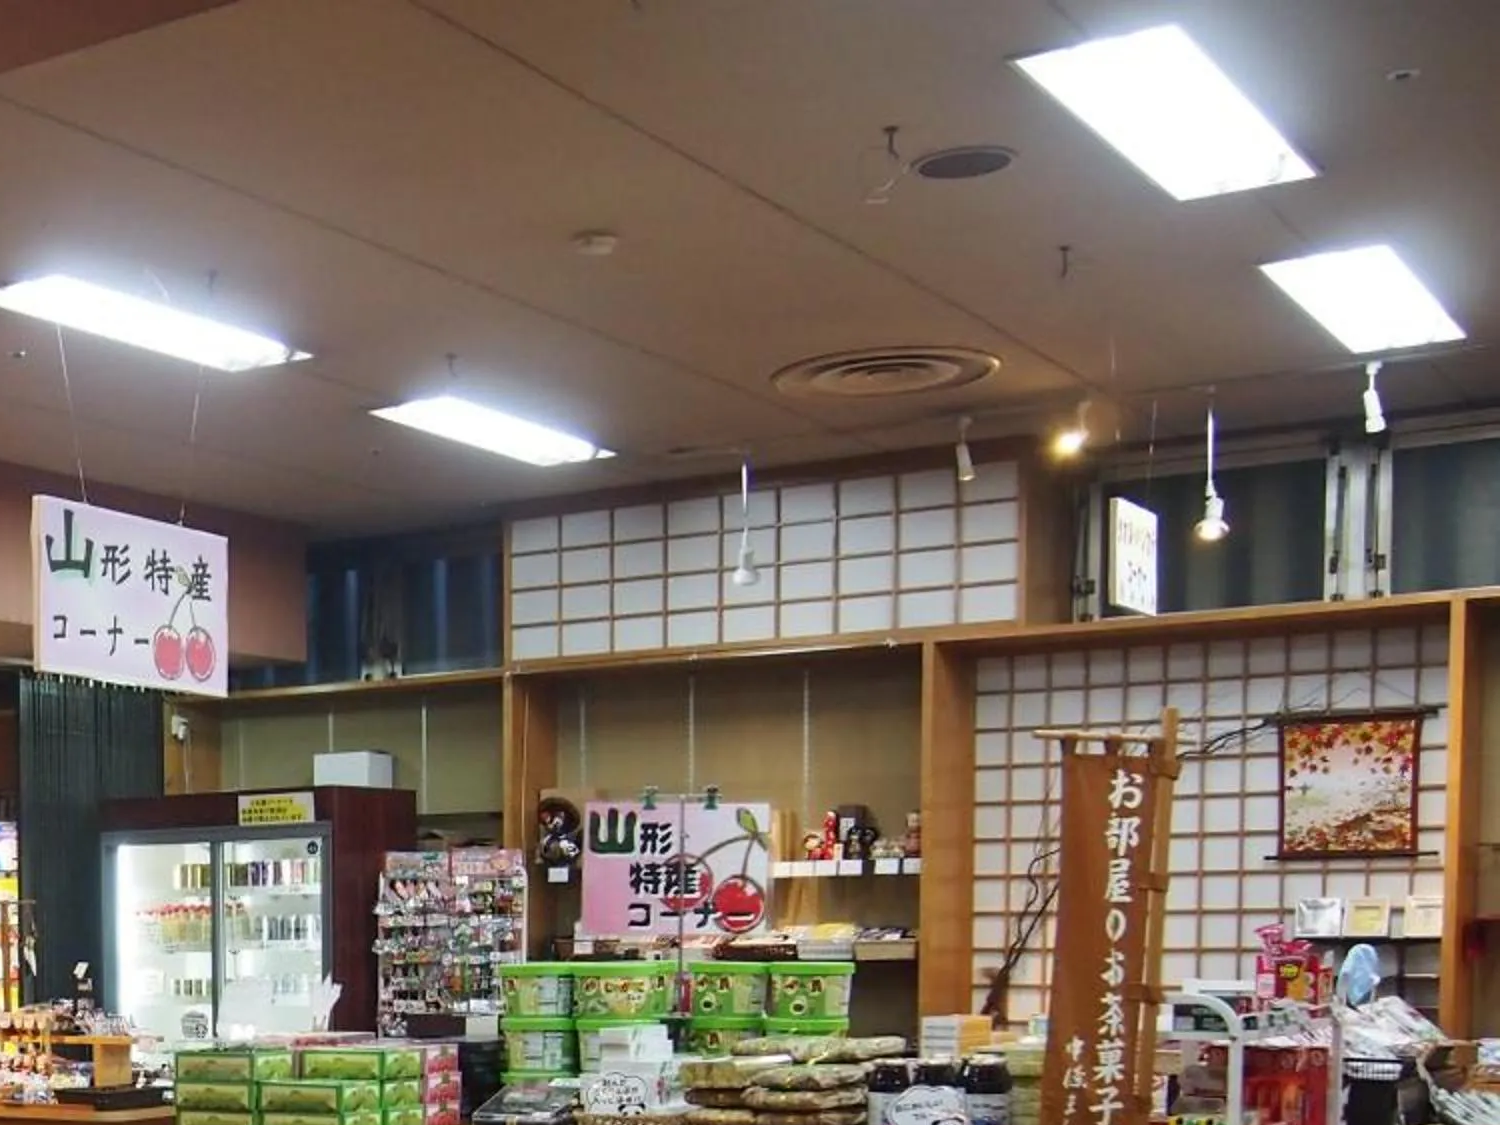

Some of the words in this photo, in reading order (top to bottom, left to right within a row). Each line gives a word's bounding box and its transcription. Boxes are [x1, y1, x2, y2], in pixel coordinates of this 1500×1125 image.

[45, 508, 212, 602] 山形特産
[53, 615, 150, 656] コーナー
[589, 807, 673, 854] 山形
[629, 860, 697, 895] 特産
[627, 902, 755, 928] コーナー
